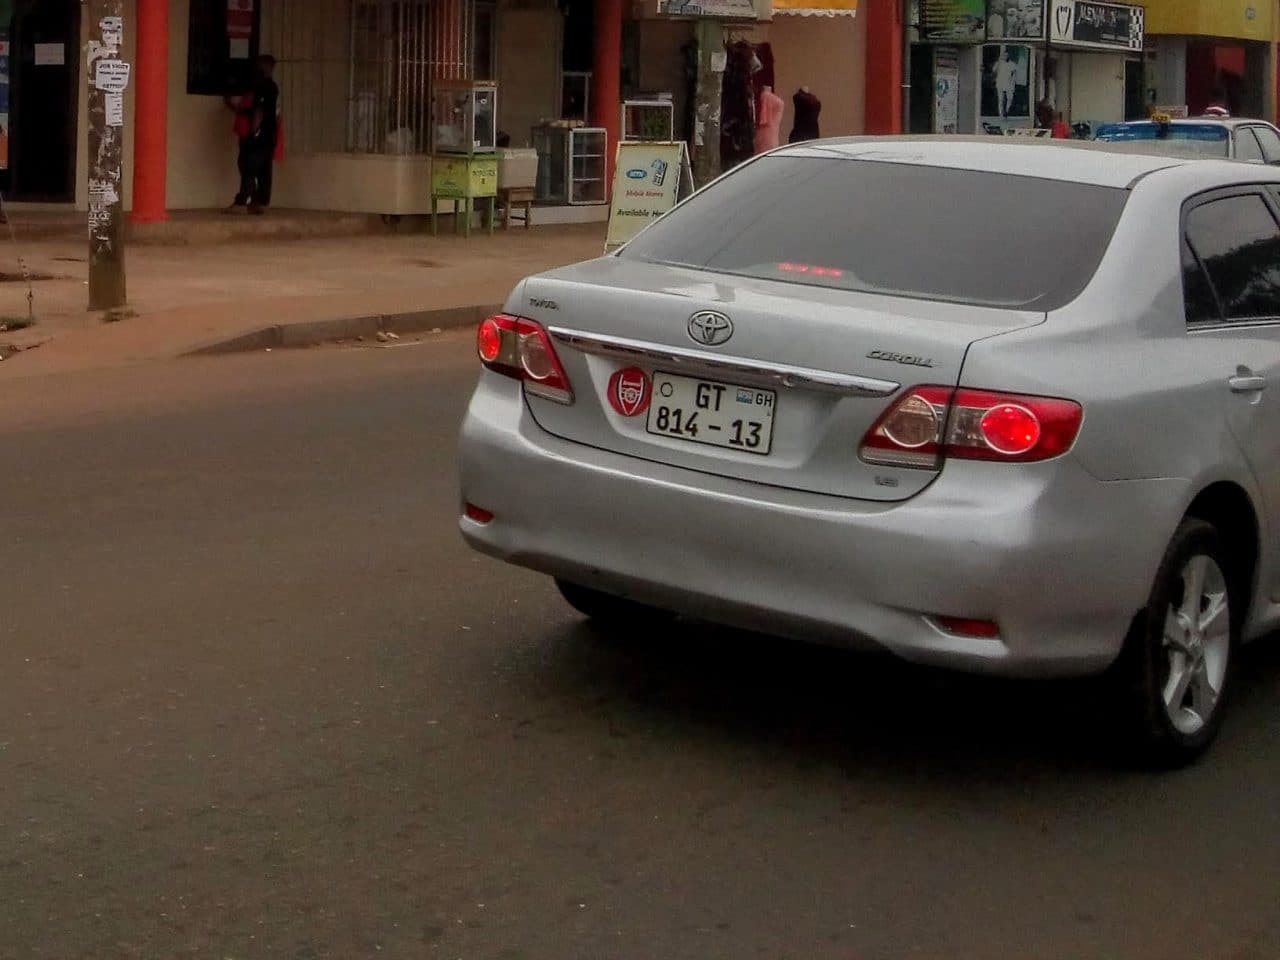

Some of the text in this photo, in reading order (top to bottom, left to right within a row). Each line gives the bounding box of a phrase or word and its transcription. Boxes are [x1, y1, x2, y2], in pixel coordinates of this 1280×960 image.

[617, 208, 650, 217] Available
[696, 383, 726, 411] GT
[756, 393, 772, 407] GH
[656, 406, 699, 437] 814
[728, 419, 762, 448] 13
